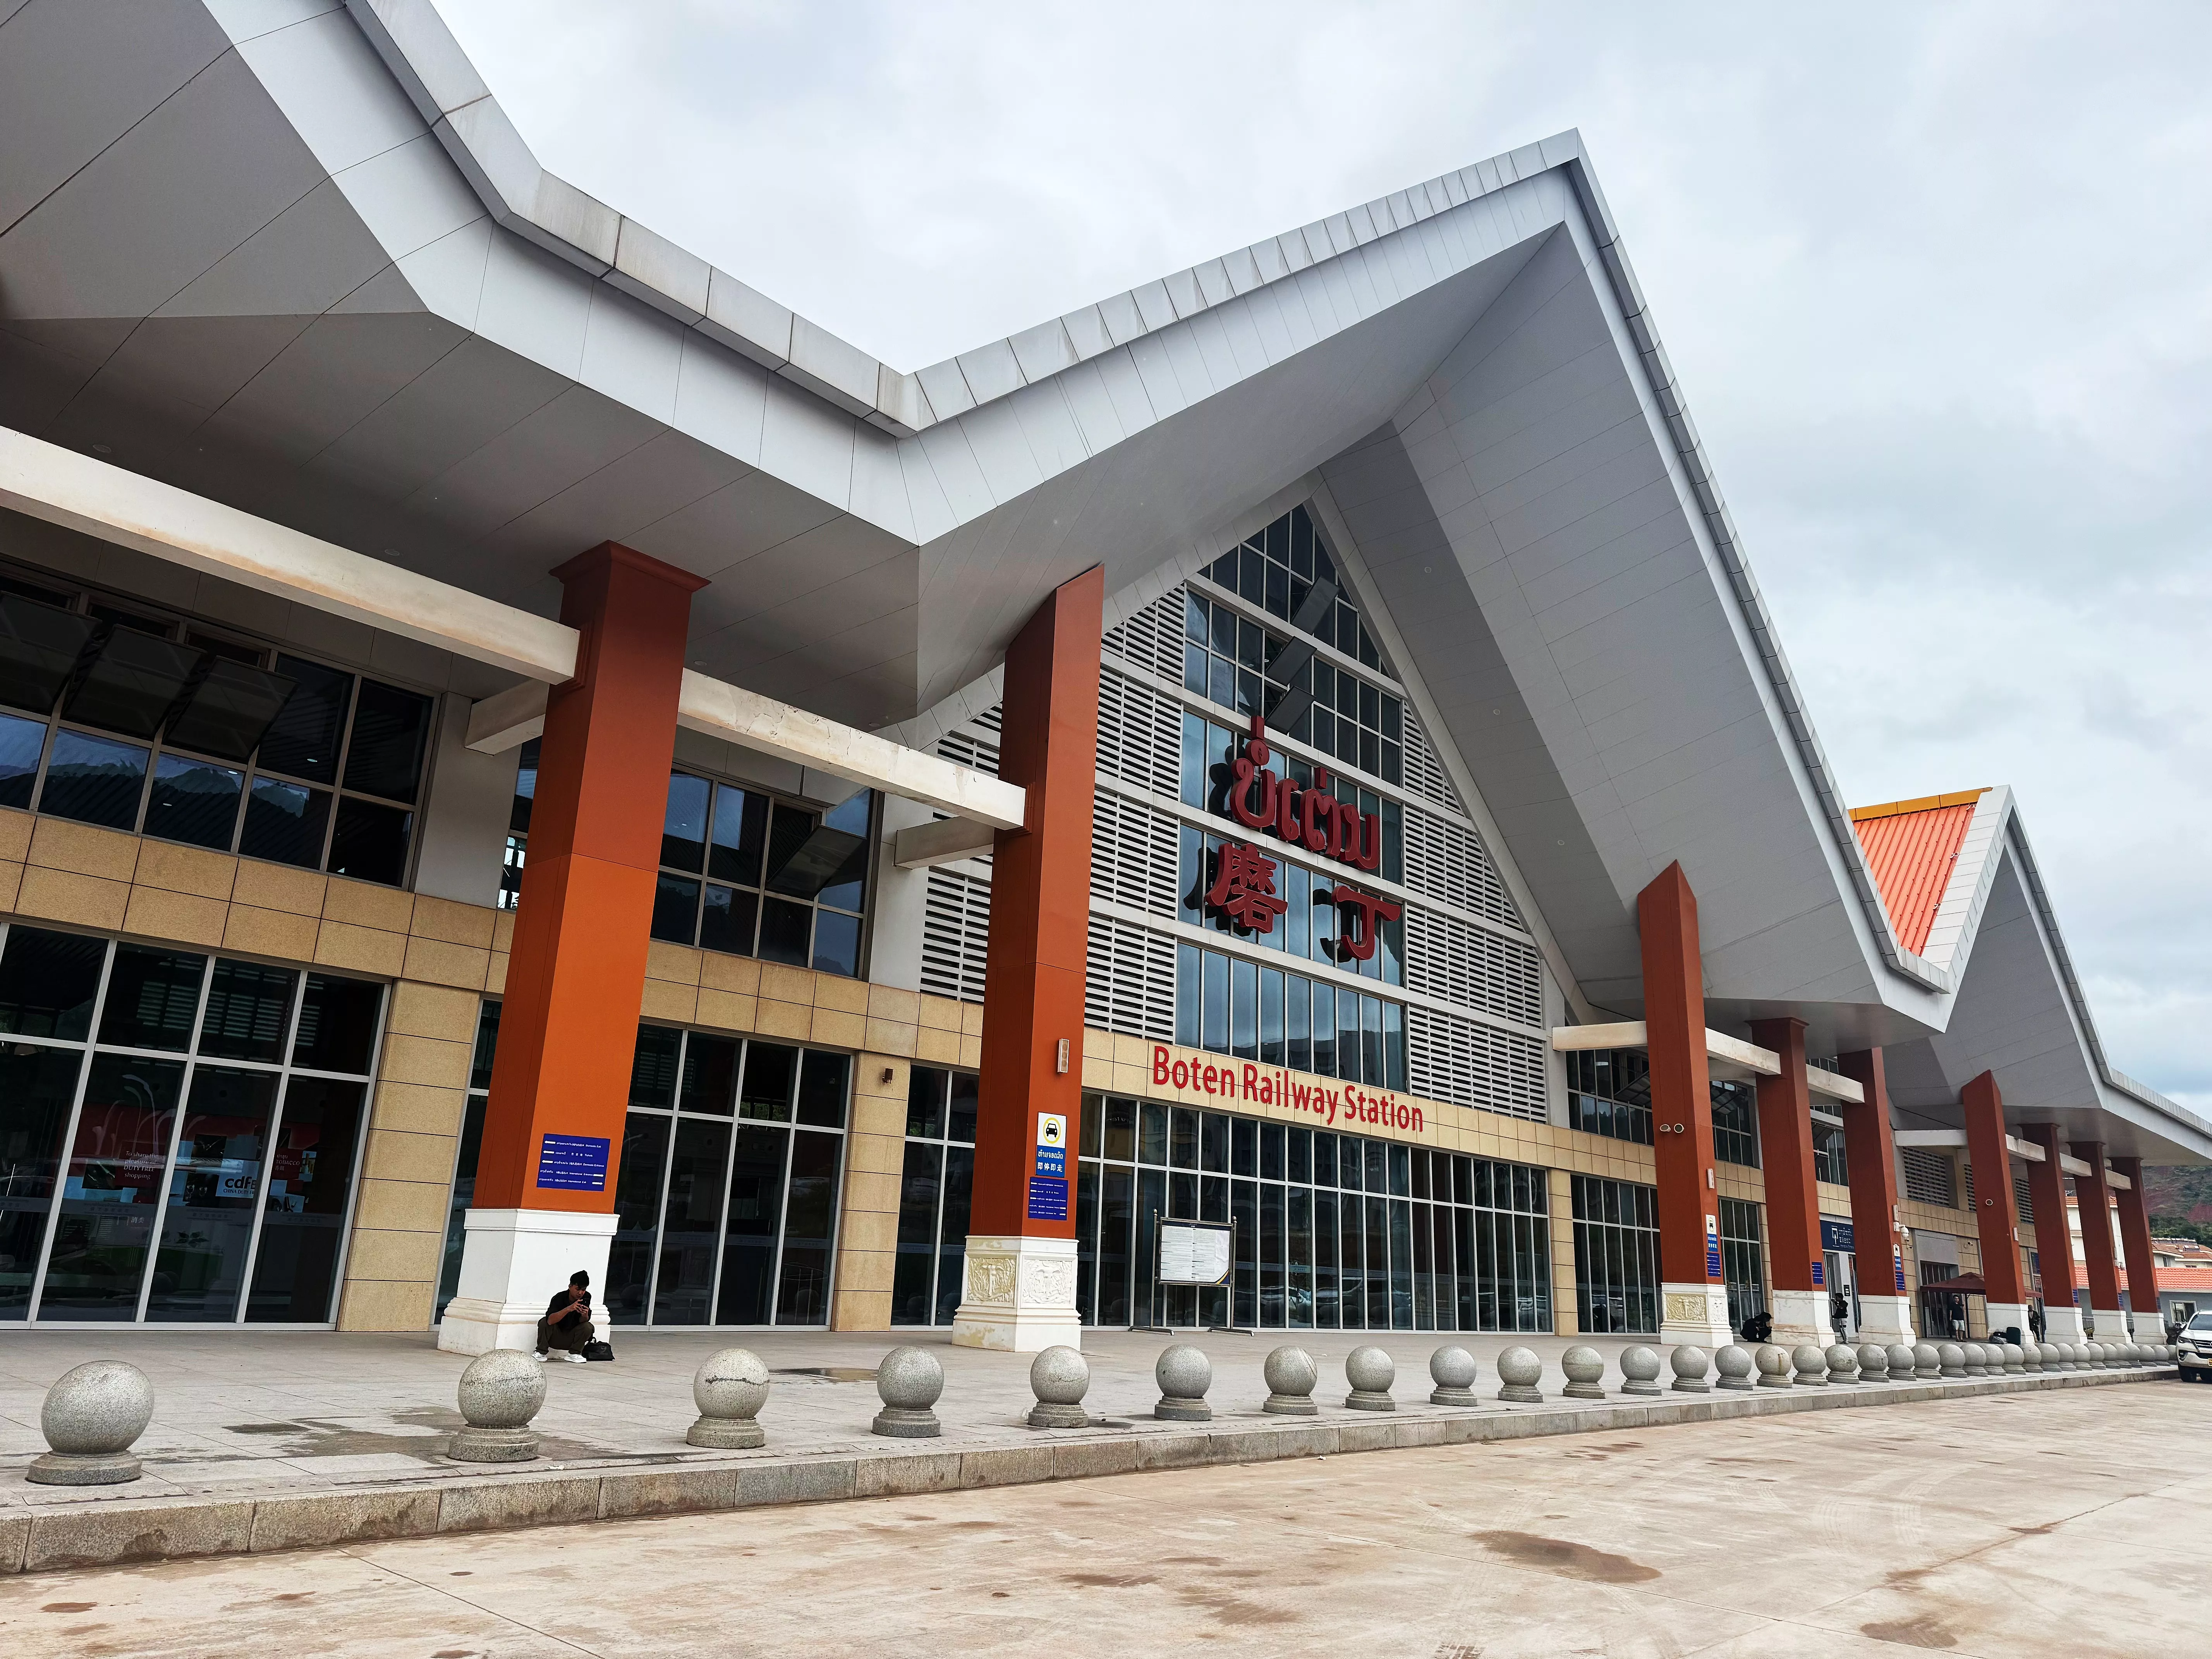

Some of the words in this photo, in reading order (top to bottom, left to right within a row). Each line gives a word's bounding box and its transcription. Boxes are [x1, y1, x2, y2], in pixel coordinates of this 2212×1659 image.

[1205, 842, 1401, 960] 磨丁
[1153, 1046, 1235, 1097] Boten
[1243, 1063, 1339, 1125] Railway
[1344, 1085, 1424, 1132] Station
[1037, 1162, 1063, 1172] 即停即走
